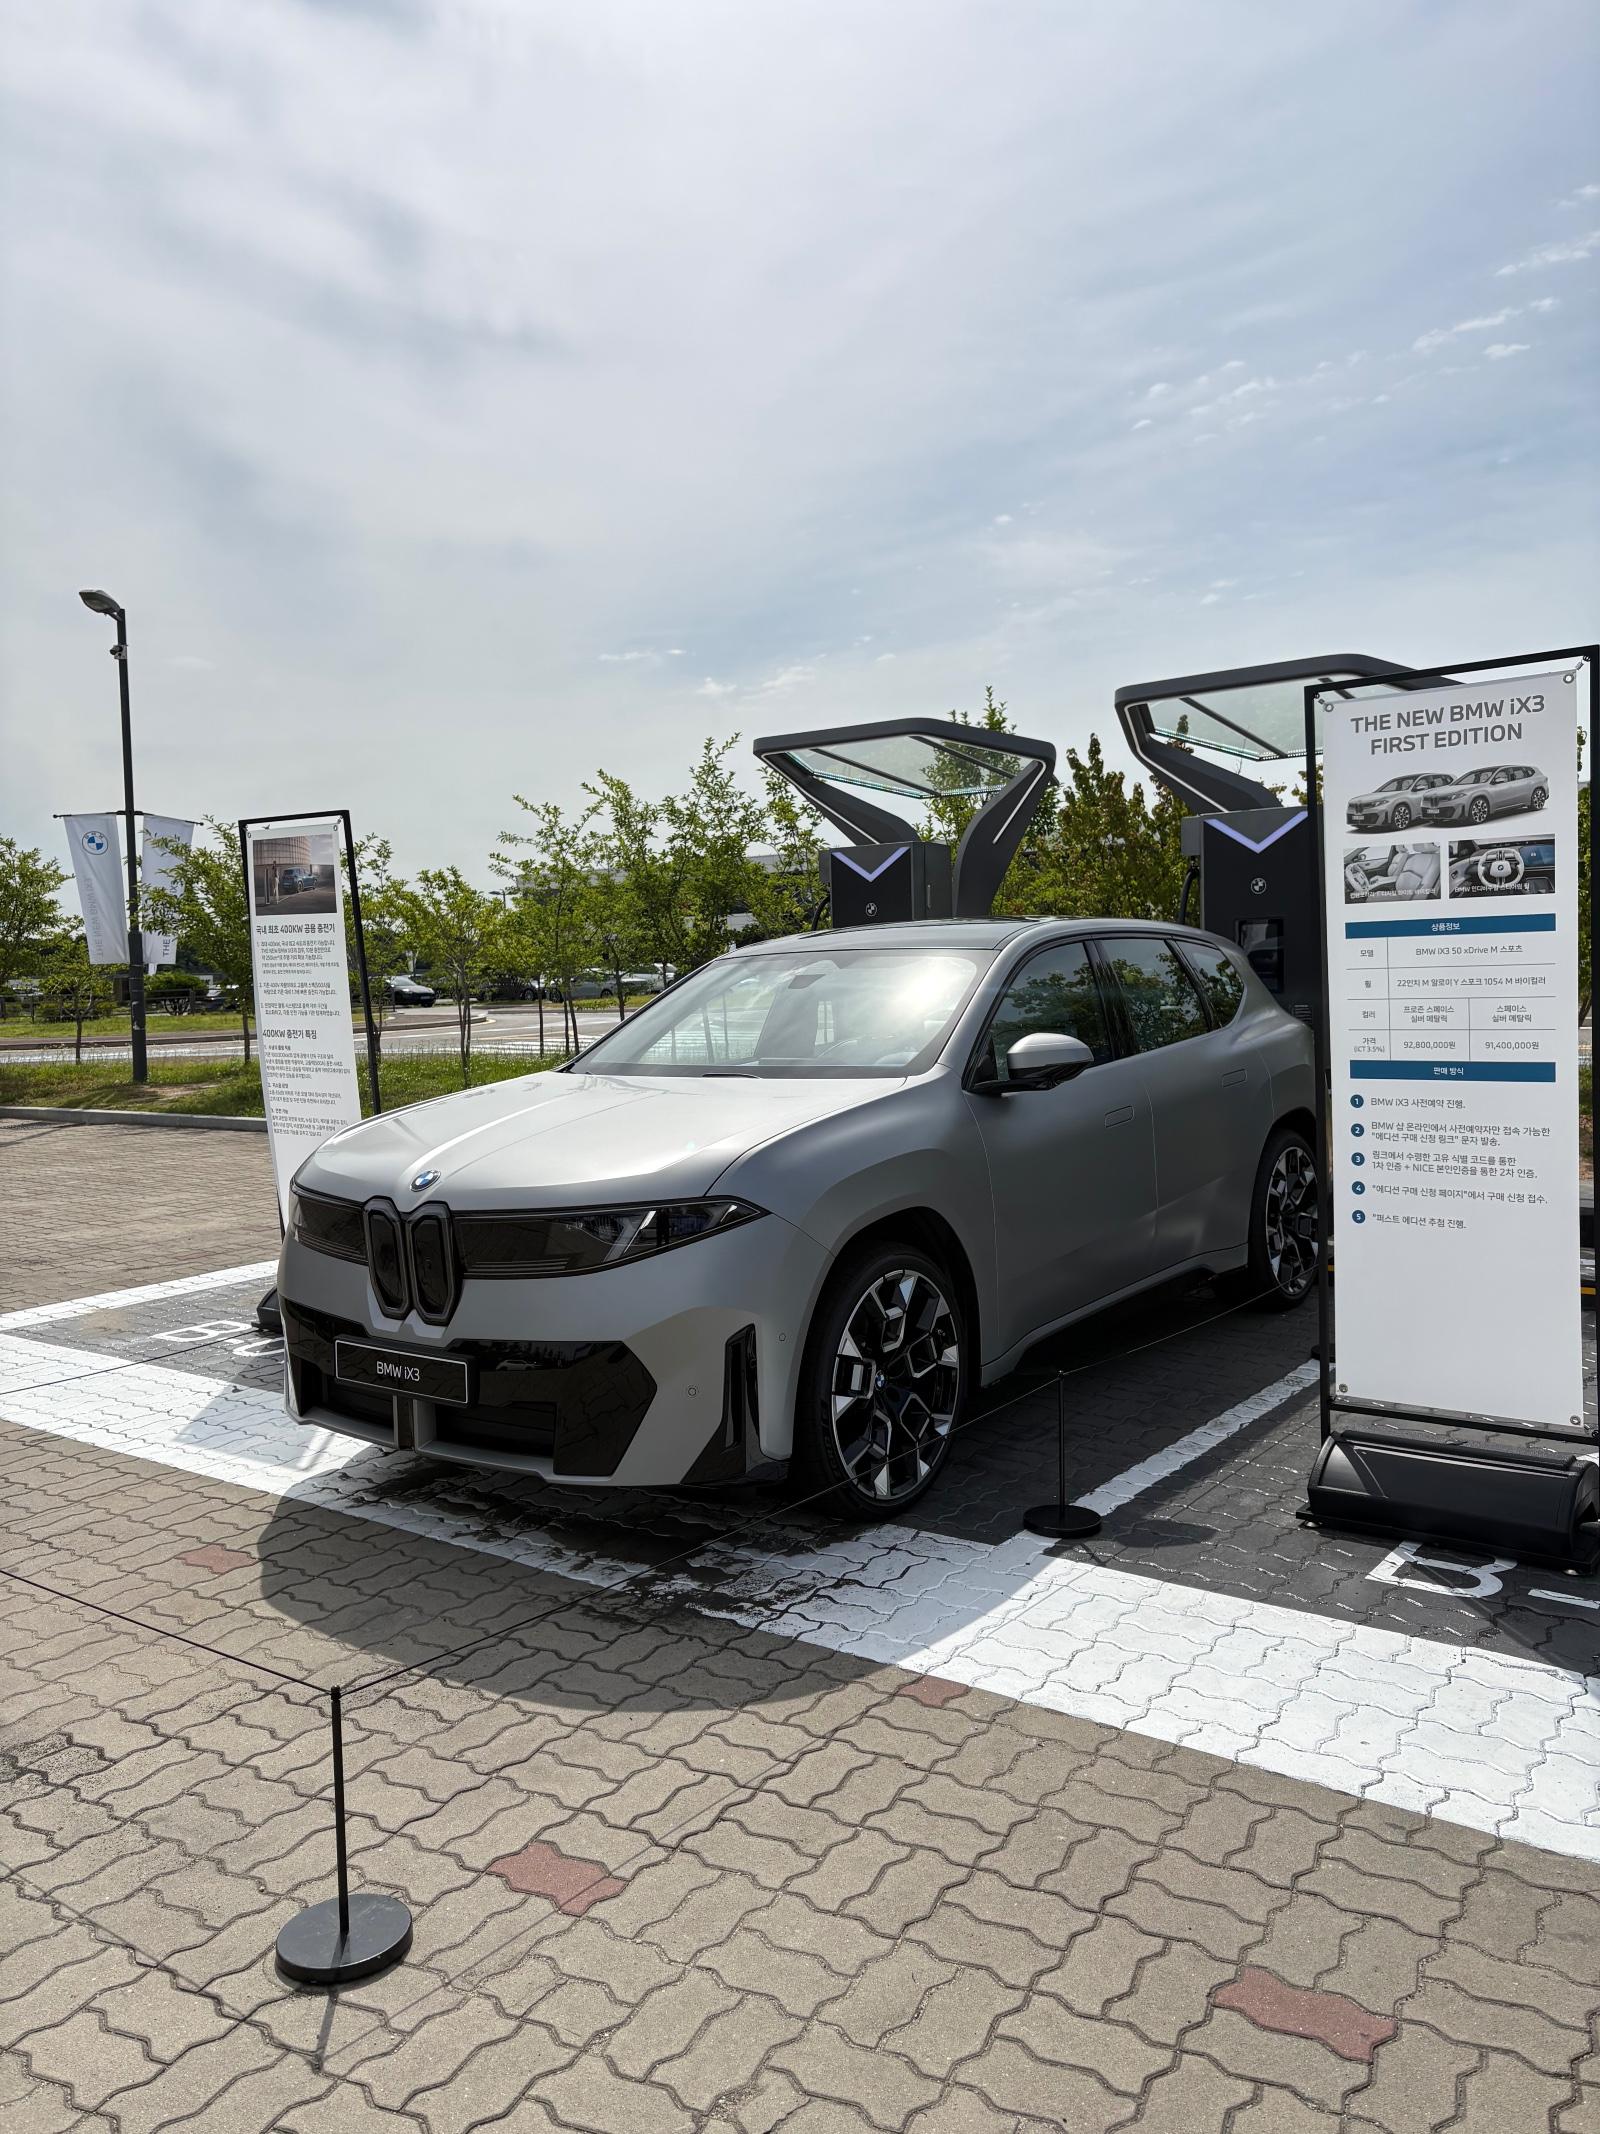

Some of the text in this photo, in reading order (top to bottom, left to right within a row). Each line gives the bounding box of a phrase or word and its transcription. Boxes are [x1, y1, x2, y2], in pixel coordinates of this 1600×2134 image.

[1351, 695, 1545, 733] THE NEW BMW iX3
[1371, 723, 1522, 755] FIRST EDITION
[256, 923, 335, 935] 국내 최초 400KW 공용 충전기
[1431, 922, 1460, 932] 상품정보
[1360, 949, 1374, 958] 모델
[1365, 980, 1372, 988] 휠
[1397, 979, 1420, 987] 22인치
[1431, 978, 1453, 986] 알로이
[1515, 976, 1546, 985] 바이컬러
[1362, 1010, 1376, 1018] 컬러
[1403, 1005, 1455, 1013] 프로즌 스페이스
[1496, 1005, 1527, 1013] 스페이스
[1411, 1015, 1448, 1023] 실버 메탈릭
[1492, 1014, 1532, 1023] 실버 메탈릭
[262, 1030, 316, 1039] 400KW 충전기 특징
[1362, 1037, 1376, 1045] 가격
[1403, 1041, 1456, 1050] 92,800,000원
[1485, 1041, 1539, 1050] 91,400,000원
[1433, 1067, 1464, 1076] 판매 방식
[1371, 1098, 1393, 1106] BMW
[1395, 1098, 1409, 1106] iX3
[1411, 1099, 1444, 1108] 사전예약
[1447, 1099, 1465, 1109] 진행.
[1372, 1121, 1394, 1129] BMW
[1406, 1123, 1446, 1132] 온라인에서
[1449, 1124, 1500, 1135] 사전예약자만
[1503, 1126, 1520, 1135] 접속
[1523, 1127, 1550, 1136] 가능한
[1372, 1132, 1500, 1146] "에디션 구매 신청 링크" 문자 발송.
[1372, 1151, 1404, 1160] 링크에서
[1433, 1154, 1449, 1163] 고유
[1452, 1155, 1468, 1164] 식별
[1470, 1155, 1495, 1165] 코드를
[1498, 1157, 1516, 1166] 통한
[1372, 1161, 1384, 1170] 1차
[1386, 1163, 1401, 1171] 인증
[1413, 1164, 1434, 1172] NICE
[1436, 1164, 1478, 1176] 본인인증을
[1480, 1167, 1497, 1176] 통한
[1500, 1168, 1514, 1177] 2차
[1517, 1169, 1537, 1178] 인증.
[1372, 1185, 1399, 1195] "에디션
[1401, 1187, 1418, 1196] 구매
[1420, 1188, 1436, 1197] 신청
[1487, 1192, 1504, 1201] 구매
[1507, 1193, 1524, 1203] 신청
[1527, 1194, 1547, 1204] 접수.
[1402, 1216, 1426, 1226] 에디션
[1428, 1218, 1445, 1227] 추첨
[1447, 1219, 1467, 1229] 진행.
[376, 1361, 420, 1382] BMW iX3
